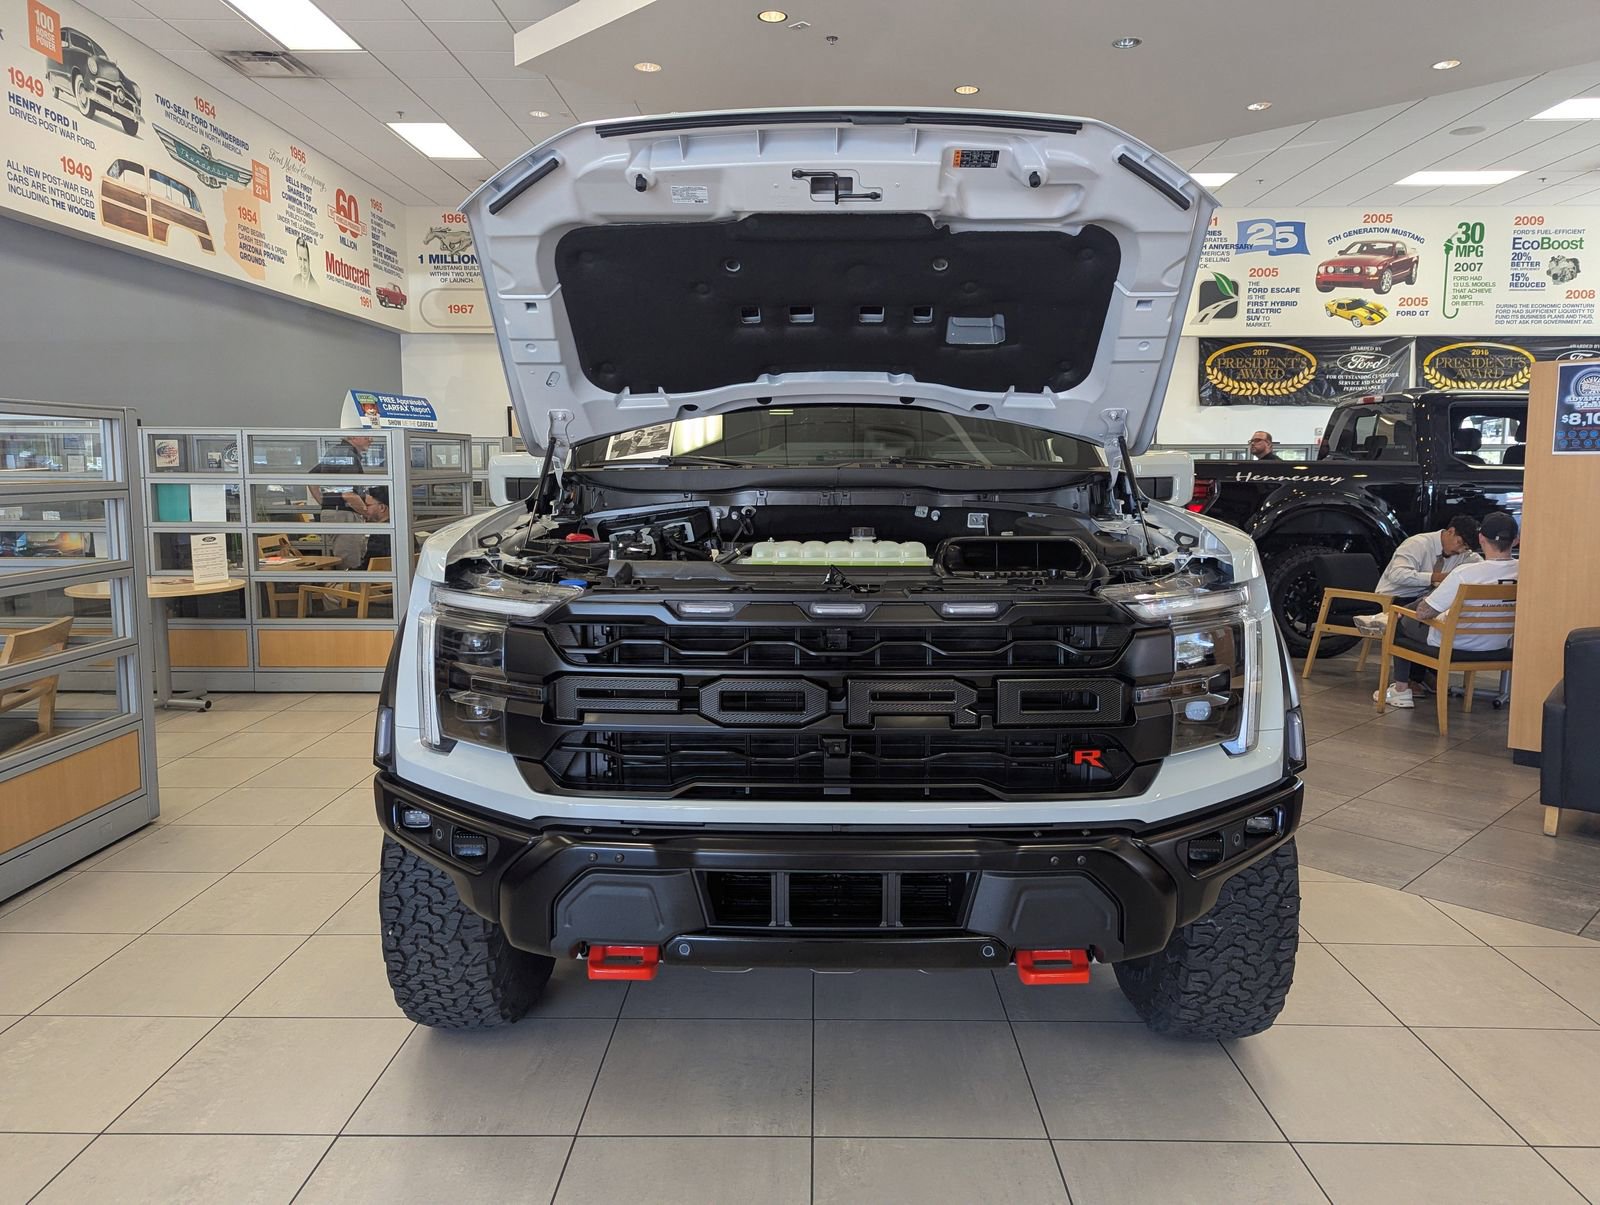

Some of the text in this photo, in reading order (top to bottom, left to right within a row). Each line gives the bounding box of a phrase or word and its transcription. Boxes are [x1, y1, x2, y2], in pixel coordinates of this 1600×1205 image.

[34, 8, 54, 33] 100
[36, 33, 56, 52] POWER
[8, 66, 44, 97] 1949
[8, 91, 78, 131] HENRY FORD II
[194, 95, 217, 120] 1954
[9, 105, 97, 151] DRIVES POST WAR FORD.
[155, 93, 250, 151] TWO-SEAT FORD THUNDERBIRD
[164, 110, 222, 145] INTRODUCED IN NORTH
[290, 146, 306, 164] 1956
[60, 155, 93, 182] 1949
[6, 160, 94, 199] ALL NEW POST-WAR ERA
[6, 172, 95, 209] CARS ARE INTRODUCED
[8, 184, 96, 220] INCLUDING THE WOODIE
[238, 207, 257, 225] 1954
[336, 188, 359, 238] 60
[1363, 214, 1393, 224] 2005
[1514, 216, 1544, 226] 2009
[1247, 222, 1298, 249] 25
[1328, 227, 1425, 245] 5TH GENERATION MUSTANG
[1456, 222, 1485, 244] 30
[1455, 245, 1484, 258] MPG
[1512, 236, 1584, 250] EcoBoost
[239, 241, 285, 264] ARIZONA PROVING
[418, 254, 478, 264] 1 MILLION
[1512, 252, 1532, 260] 20%
[325, 250, 370, 288] Motorcraft
[1248, 268, 1279, 278] 2005
[1454, 262, 1484, 272] 2007
[1510, 272, 1530, 282] 15%
[1398, 297, 1428, 306] 2005
[1566, 290, 1596, 300] 2008
[448, 304, 474, 314] 1967
[1217, 358, 1308, 369] PRESIDENT'S
[1348, 354, 1384, 369] Ford
[1436, 355, 1526, 369] PRESIDENT'S
[1236, 368, 1285, 379] AWARD
[1454, 369, 1504, 378] AWARD
[378, 396, 396, 404] FREE
[382, 404, 432, 414] CARFAX Report
[1236, 471, 1345, 485] Hennessey
[554, 675, 1124, 729] FORD
[1074, 750, 1105, 768] R
